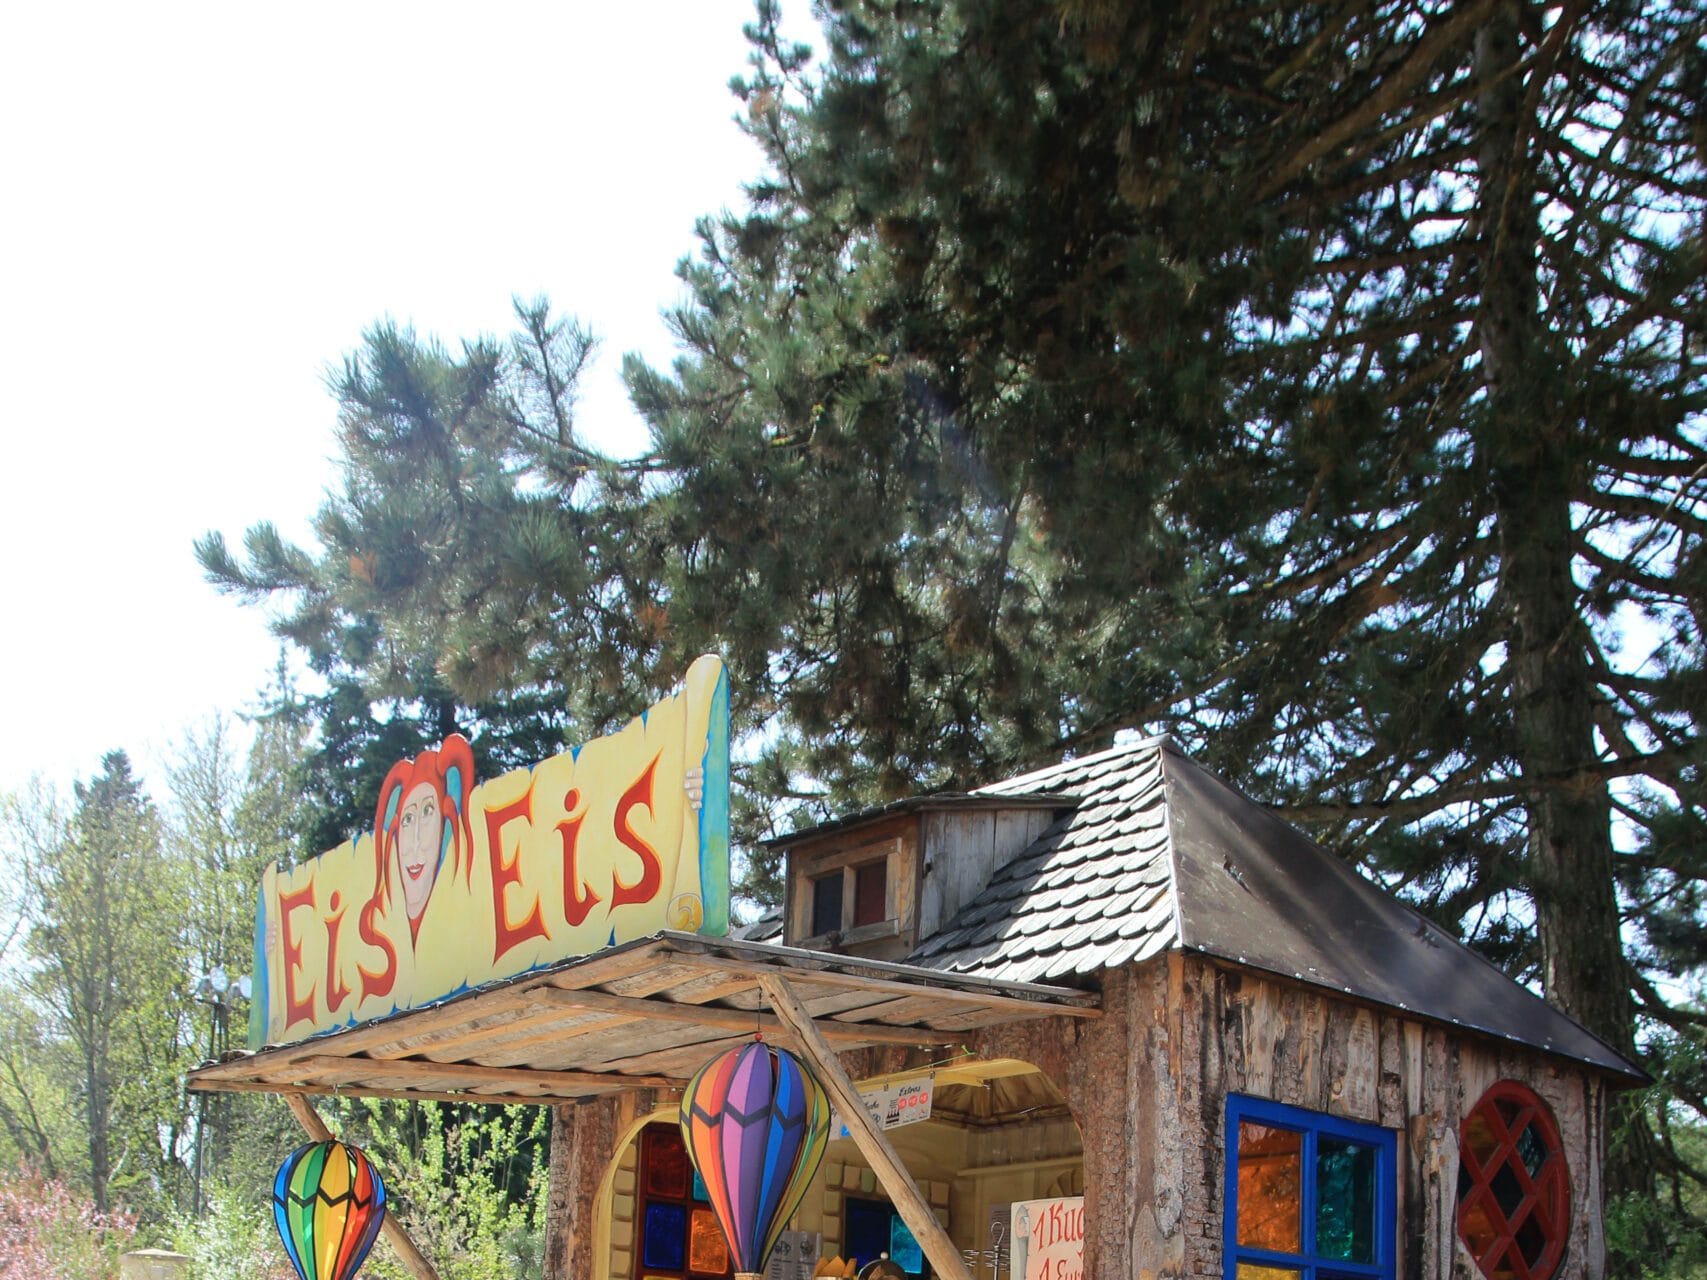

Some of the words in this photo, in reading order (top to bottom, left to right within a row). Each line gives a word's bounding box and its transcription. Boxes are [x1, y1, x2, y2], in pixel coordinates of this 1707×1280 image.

[278, 874, 398, 1033] Eis
[483, 747, 664, 968] Eis
[1033, 1210, 1045, 1251] 1
